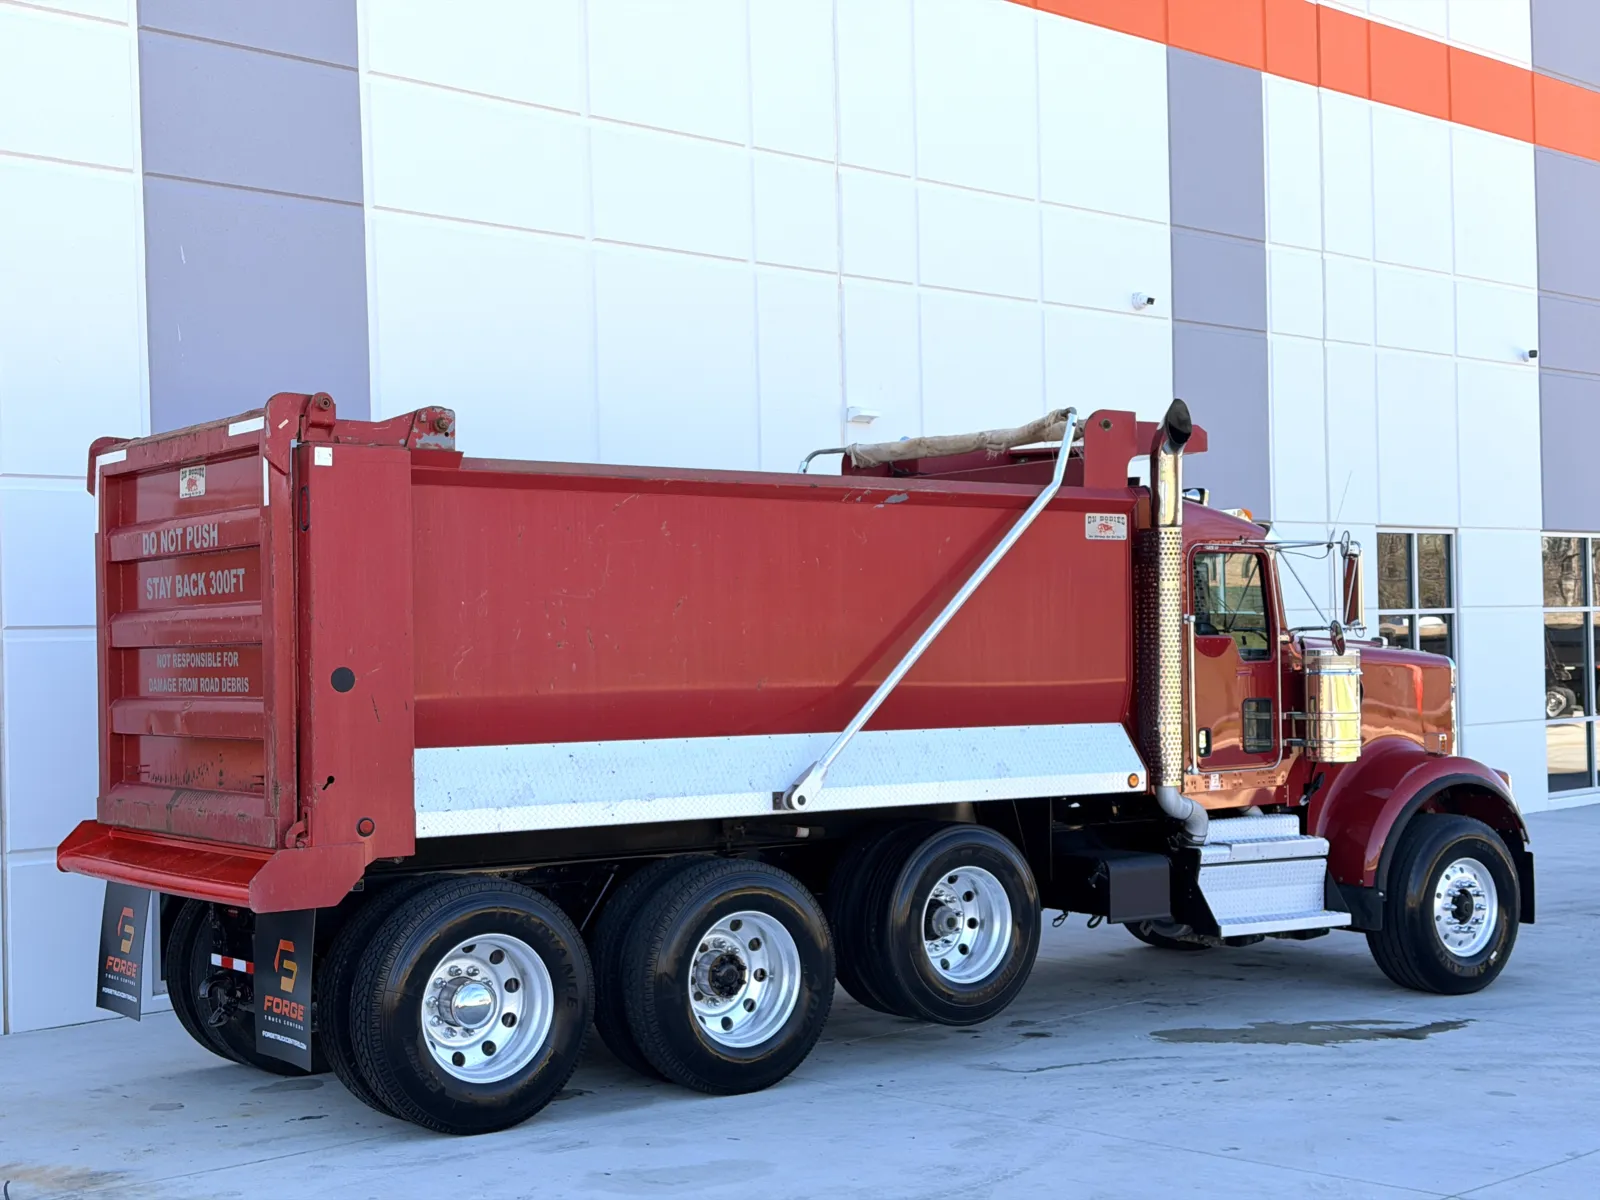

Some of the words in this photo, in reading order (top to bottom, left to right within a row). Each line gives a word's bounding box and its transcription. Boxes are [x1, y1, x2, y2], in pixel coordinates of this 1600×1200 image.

[142, 531, 157, 555] DO
[160, 527, 183, 553] NOT
[186, 523, 218, 550] PUSH
[146, 576, 173, 600] STAY
[175, 572, 207, 598] BACK
[209, 568, 245, 595] 300FT
[156, 653, 171, 669] NOT
[172, 652, 221, 668] RESPONSIBLE
[223, 652, 239, 667] FOR
[148, 678, 177, 693] DAMAGE
[178, 678, 198, 693] FROM
[200, 678, 220, 693] ROAD
[221, 677, 249, 693] DEBRIS
[105, 955, 137, 978] FORGE
[263, 995, 304, 1021] FORGE
